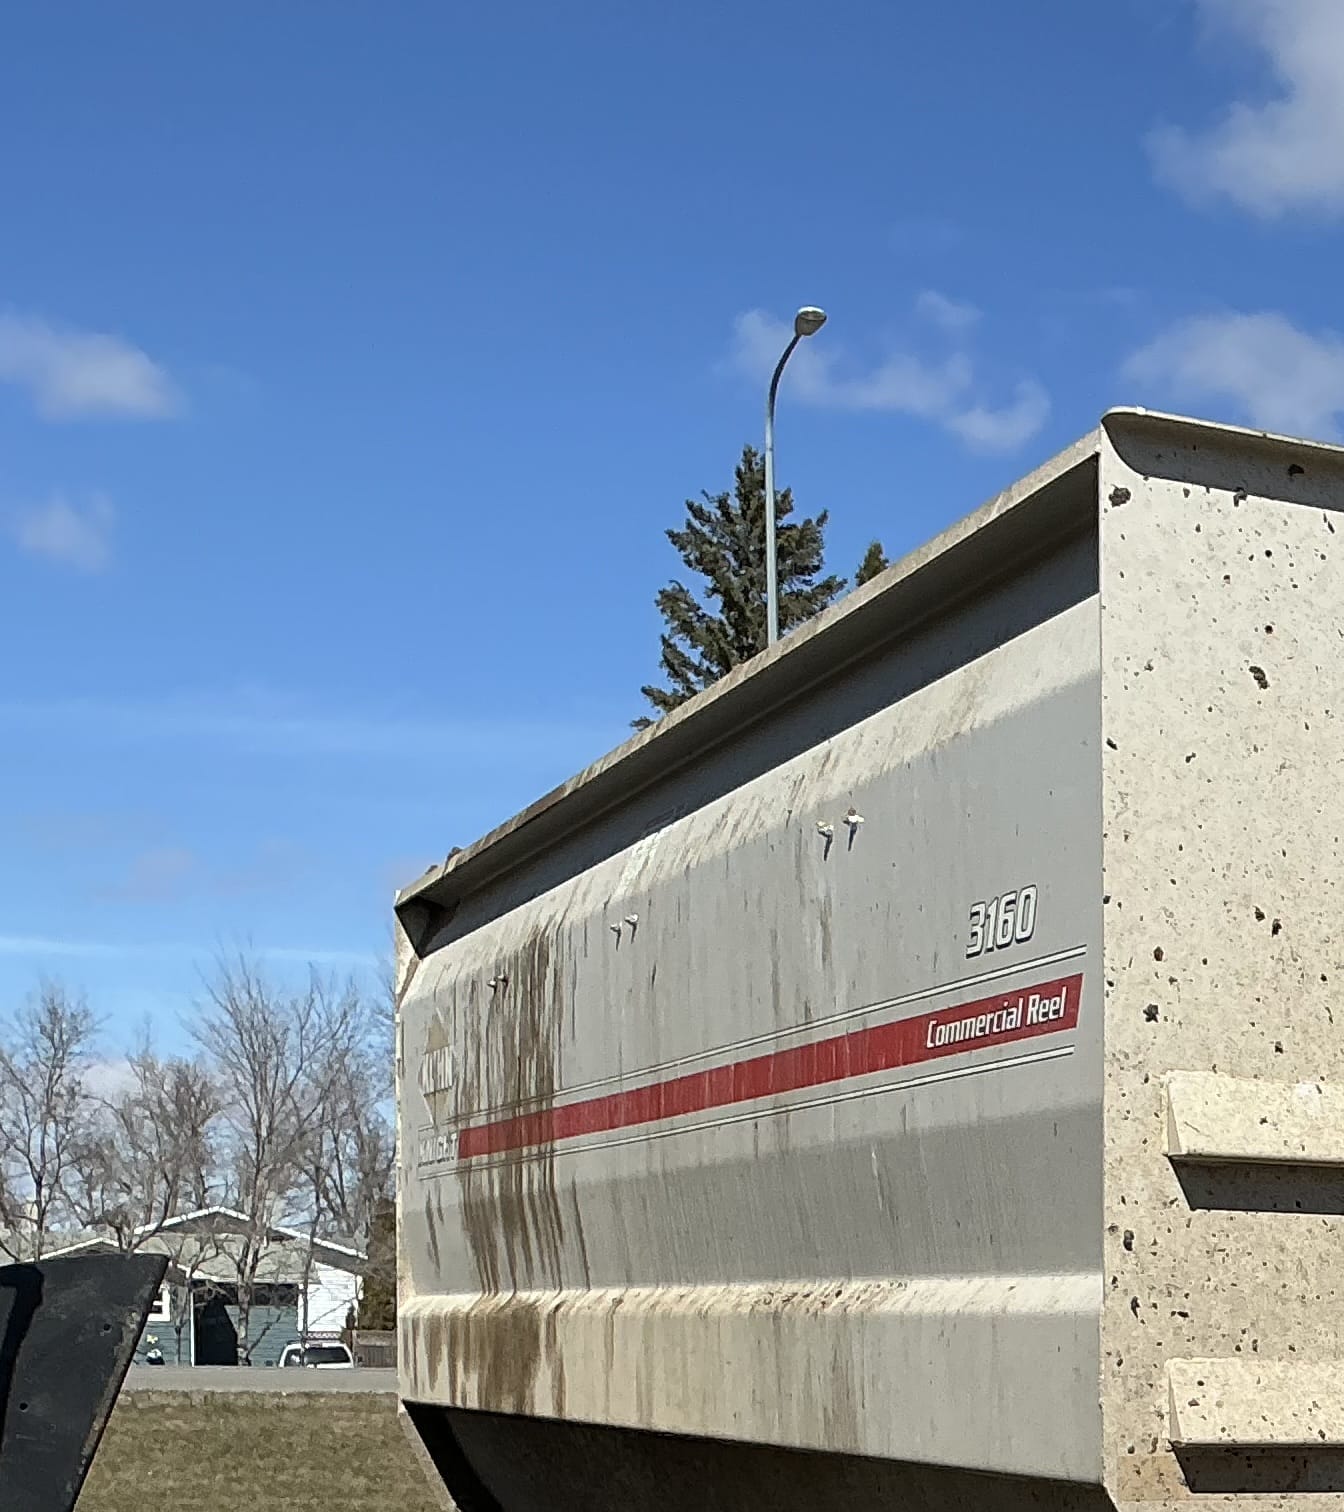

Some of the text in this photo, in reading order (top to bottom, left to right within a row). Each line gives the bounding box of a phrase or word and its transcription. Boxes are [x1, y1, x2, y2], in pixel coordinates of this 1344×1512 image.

[965, 884, 1038, 959] 3160
[926, 986, 1068, 1049] Commercial Reel
